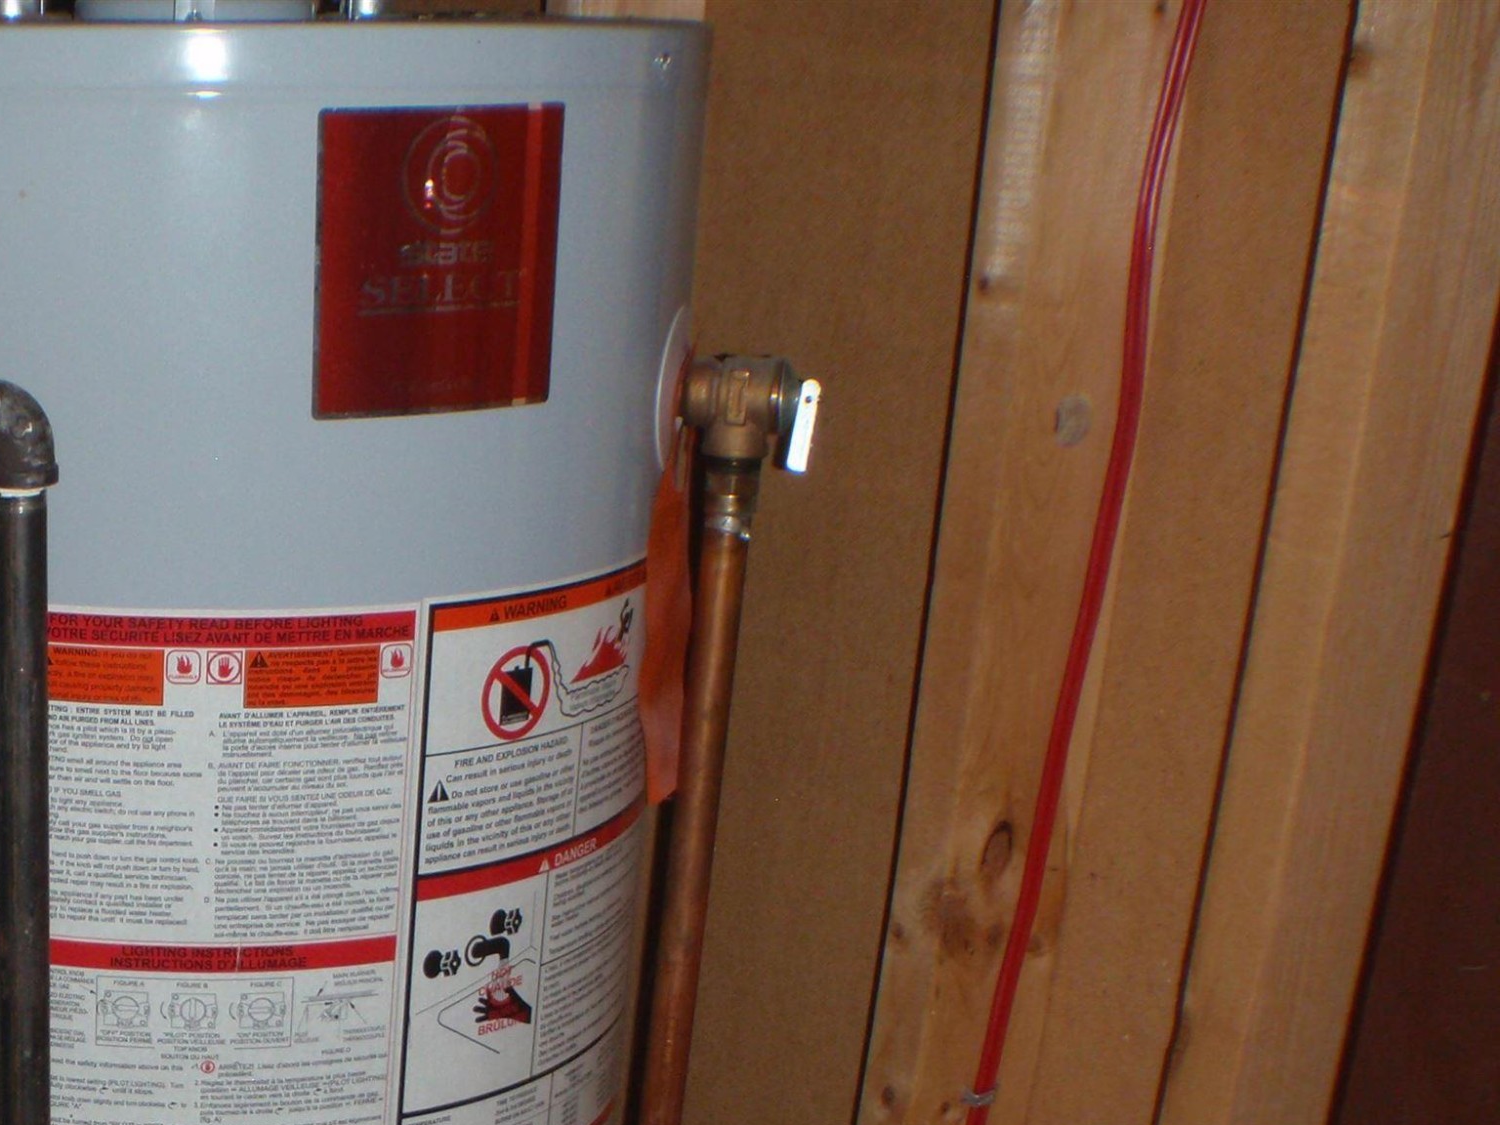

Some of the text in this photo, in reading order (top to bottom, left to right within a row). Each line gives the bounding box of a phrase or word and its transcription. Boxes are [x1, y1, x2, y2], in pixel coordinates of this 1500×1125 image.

[504, 595, 567, 620] WARNING
[50, 614, 362, 630] FOR YOUR SAFETY READ BEFORE LIGHTING
[92, 627, 158, 642] SECURITE
[164, 630, 200, 643] LISEZ
[206, 632, 248, 644] AVANT
[254, 632, 271, 644] DE
[276, 631, 328, 644] METTRE
[334, 630, 350, 642] EN
[355, 624, 408, 641] MARCHE
[59, 714, 68, 723] AIR
[71, 715, 97, 724] PURGED
[100, 716, 118, 725] FROM
[121, 717, 132, 726] ALL
[76, 706, 194, 719] ENTIRE SYSTEM MUST BE FILLED
[455, 736, 568, 768] FIRE AND EXPLOSION HAZARD
[63, 787, 77, 796] YOU
[80, 788, 102, 797] SMELL
[106, 790, 121, 798] GAS
[554, 838, 597, 866] DANGER
[122, 945, 293, 958] LIGHTING INSTRUCTIONS
[111, 956, 306, 970] INSTRUCTIONS D'ALLUMAGE
